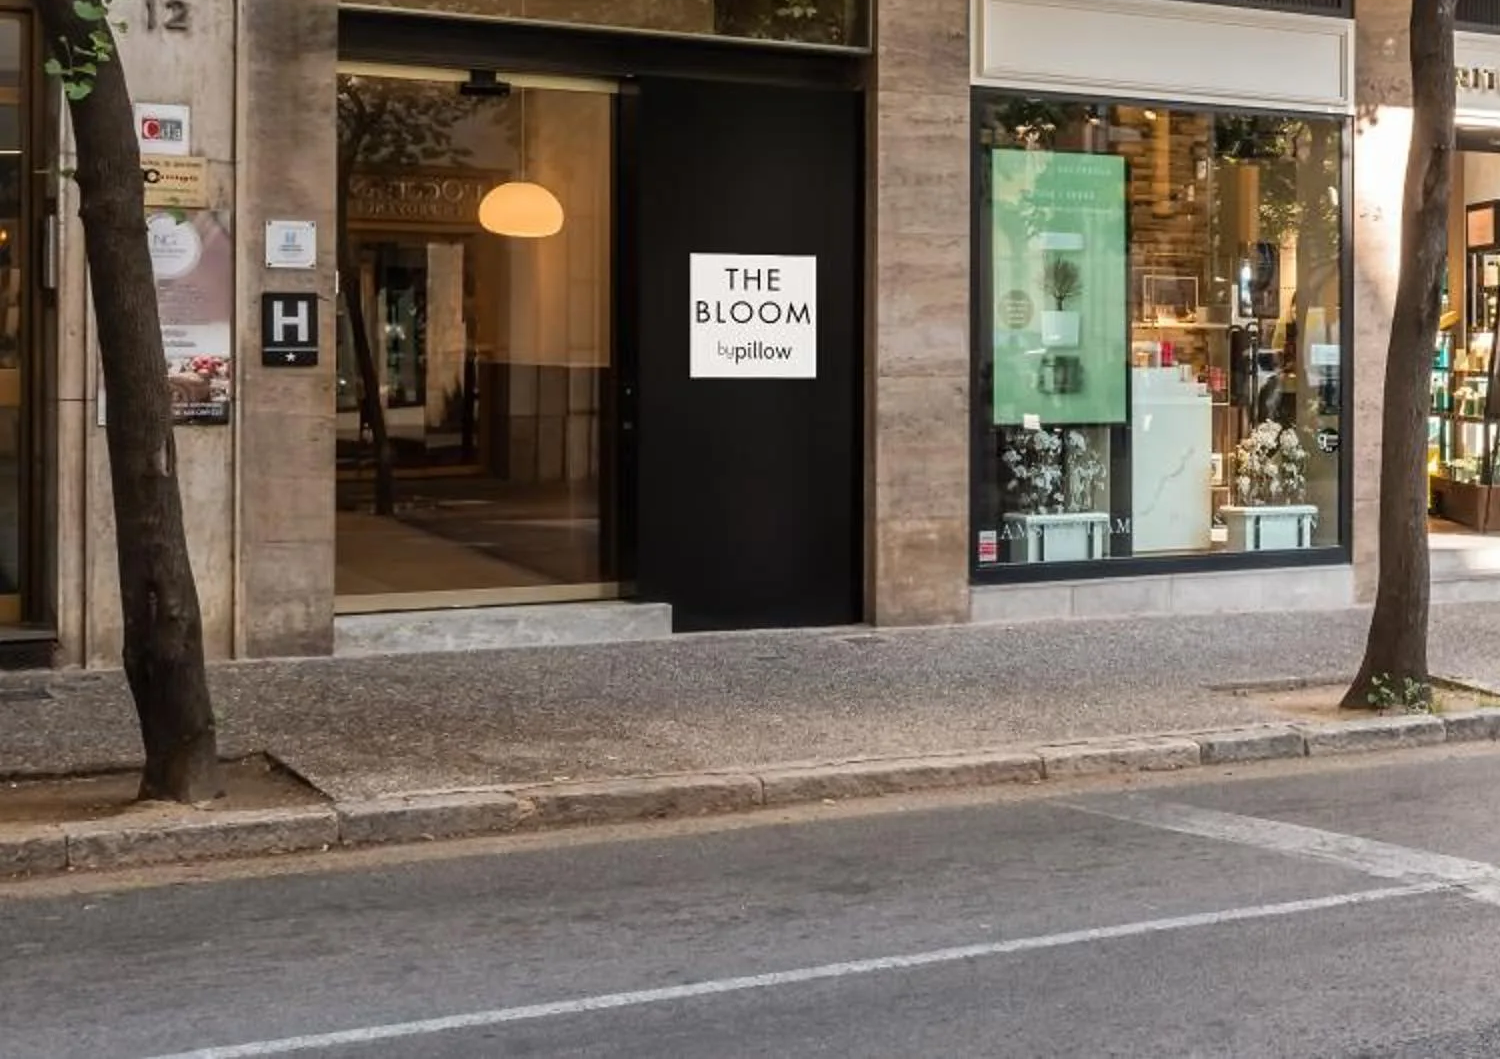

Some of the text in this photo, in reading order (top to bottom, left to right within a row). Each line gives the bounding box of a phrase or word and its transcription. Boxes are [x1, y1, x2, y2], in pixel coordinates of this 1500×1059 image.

[724, 268, 781, 291] THE
[273, 300, 309, 342] H
[695, 300, 811, 325] BLOOM
